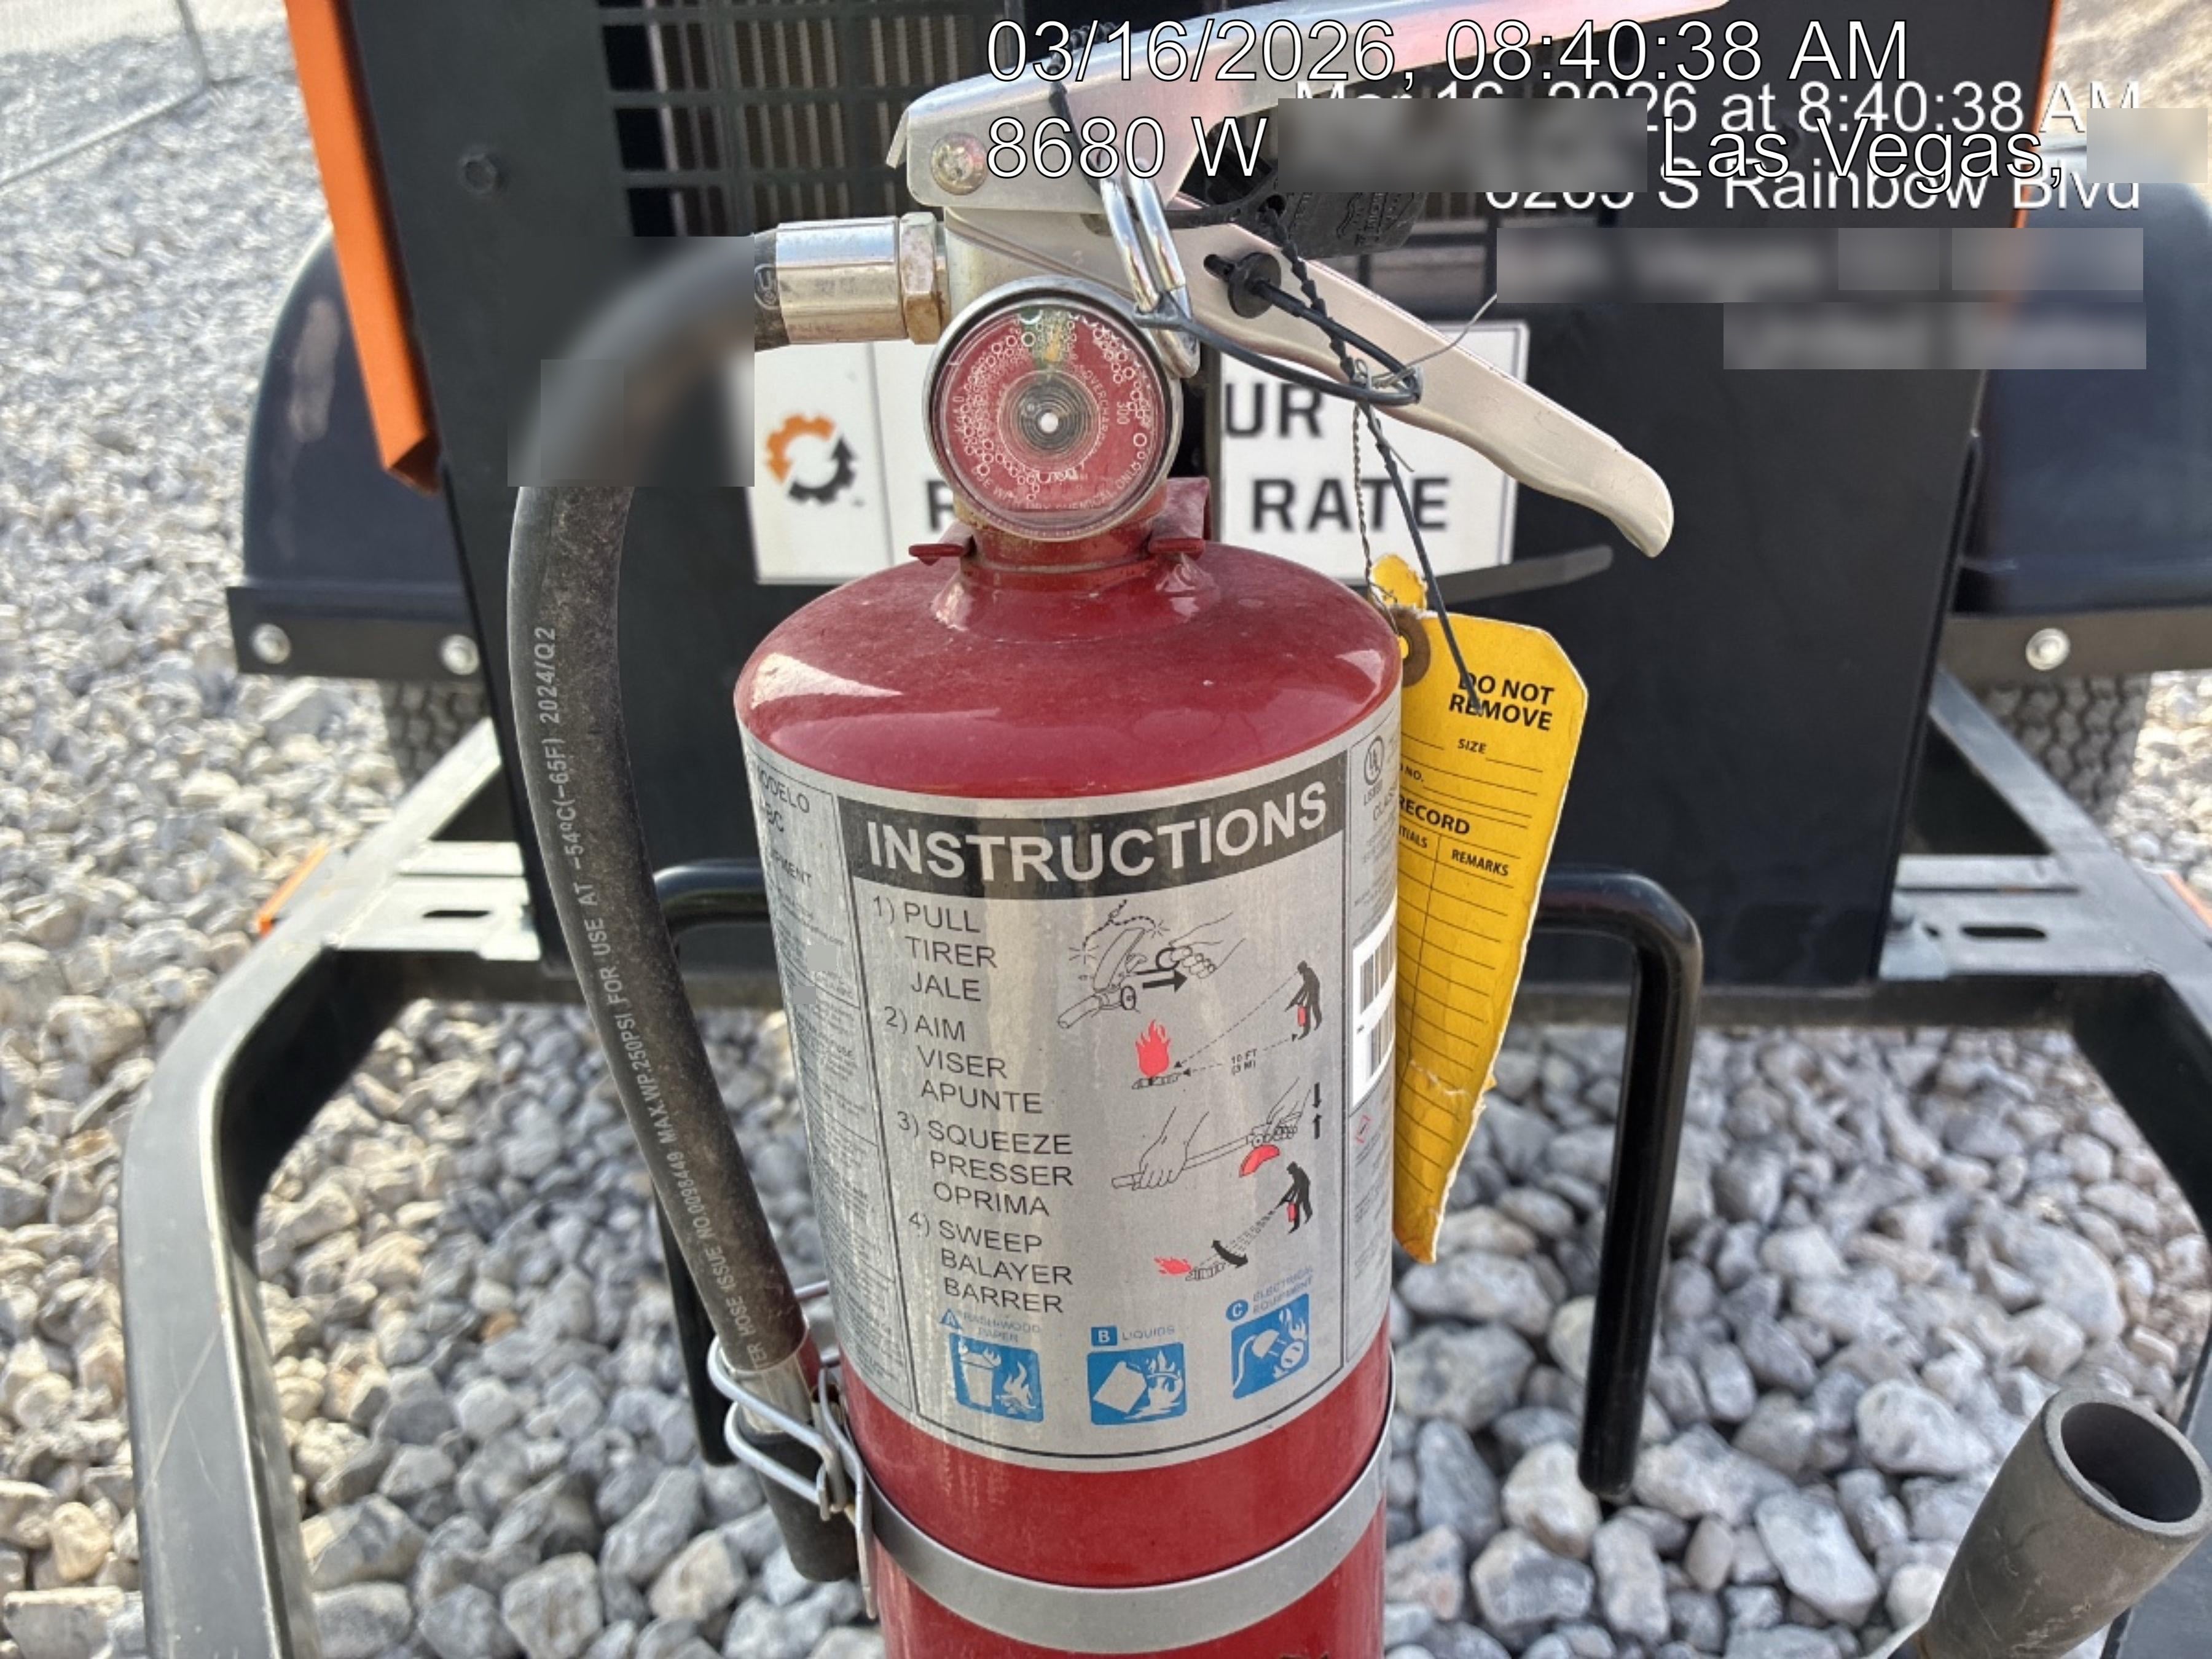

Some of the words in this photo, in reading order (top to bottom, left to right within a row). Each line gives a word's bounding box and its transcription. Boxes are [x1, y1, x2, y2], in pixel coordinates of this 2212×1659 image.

[1252, 477, 1450, 533] RATE
[533, 626, 560, 724] 2024/Q2
[1458, 672, 1496, 694] DO
[1501, 678, 1555, 706] NOT
[1448, 692, 1553, 731] REMOVE
[1457, 738, 1486, 755] SIZE
[758, 766, 810, 814] ODELO
[866, 779, 1327, 884] INSTRUCTIONS
[1451, 849, 1510, 877] REMARKS
[573, 882, 598, 906] AT
[873, 895, 895, 924] 1)
[904, 901, 981, 933] PULL
[584, 917, 611, 956] USE
[904, 935, 998, 969] TIRER
[599, 967, 627, 1006] FOR
[910, 971, 982, 1002] JALE
[884, 1005, 908, 1035] 2)
[914, 1014, 966, 1043] AIM
[917, 1045, 1008, 1080] VISER
[1245, 1048, 1258, 1061] FT
[921, 1079, 1043, 1115] APUNTE
[897, 1110, 919, 1138] 3)
[928, 1120, 1073, 1155] SQUEEZE
[930, 1150, 1074, 1186] PRESSER
[933, 1181, 1050, 1217] OPRIMA
[908, 1211, 931, 1237] 4)
[938, 1219, 1043, 1253] SWEEP
[704, 1245, 736, 1292] ISSUE
[941, 1247, 1073, 1285] BALAYER
[943, 1276, 1064, 1314] BARRER
[1233, 1303, 1243, 1317] C
[726, 1295, 757, 1338] HOSE
[1098, 1330, 1110, 1343] B
[1122, 1325, 1175, 1341] LIQUIDS
